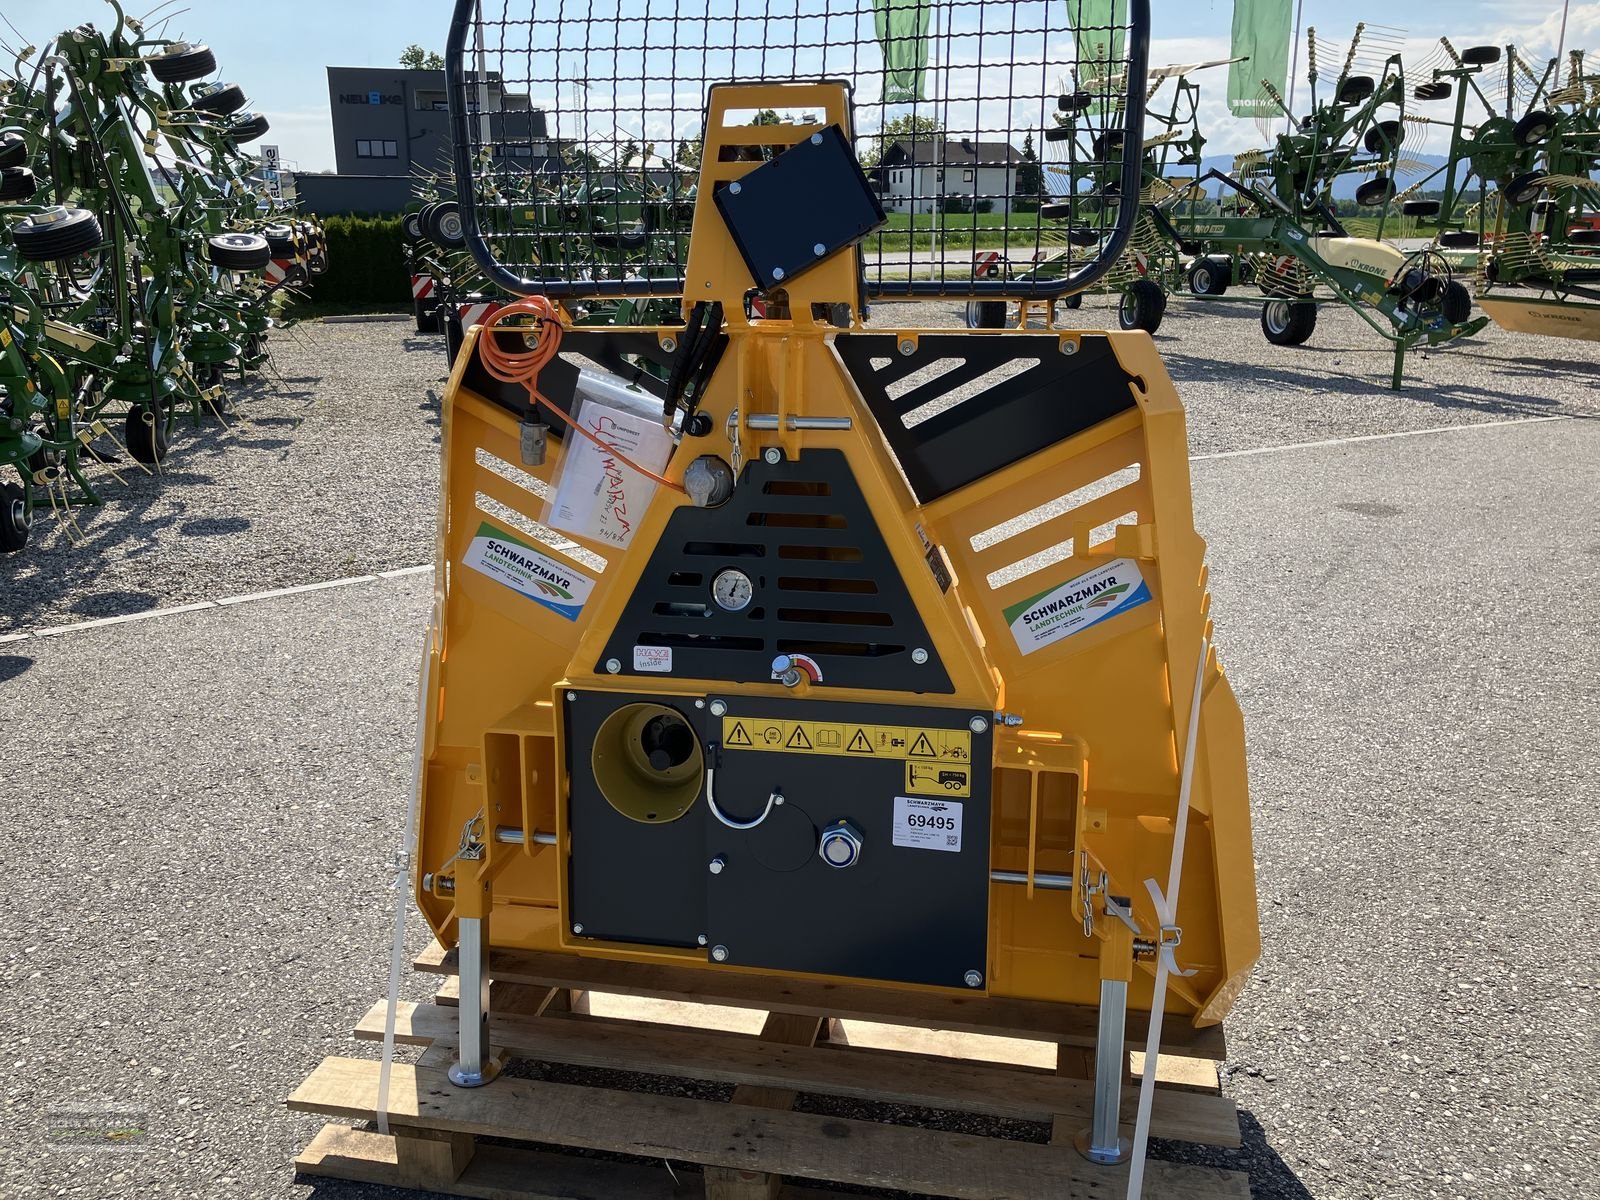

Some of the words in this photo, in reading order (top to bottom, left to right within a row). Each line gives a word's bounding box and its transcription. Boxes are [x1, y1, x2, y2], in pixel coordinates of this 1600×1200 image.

[1357, 263, 1388, 276] KRONE
[616, 426, 640, 437] UNIFOREST
[484, 551, 533, 581] LANDTECHNIK
[487, 540, 571, 590] SCHWARZMAYR
[1022, 576, 1118, 625] SCHWARZMAYR
[1029, 604, 1085, 633] LANDTECHNIK
[639, 660, 662, 668] inside
[907, 799, 945, 807] SCHWARZMAYR
[907, 813, 955, 831] 69495
